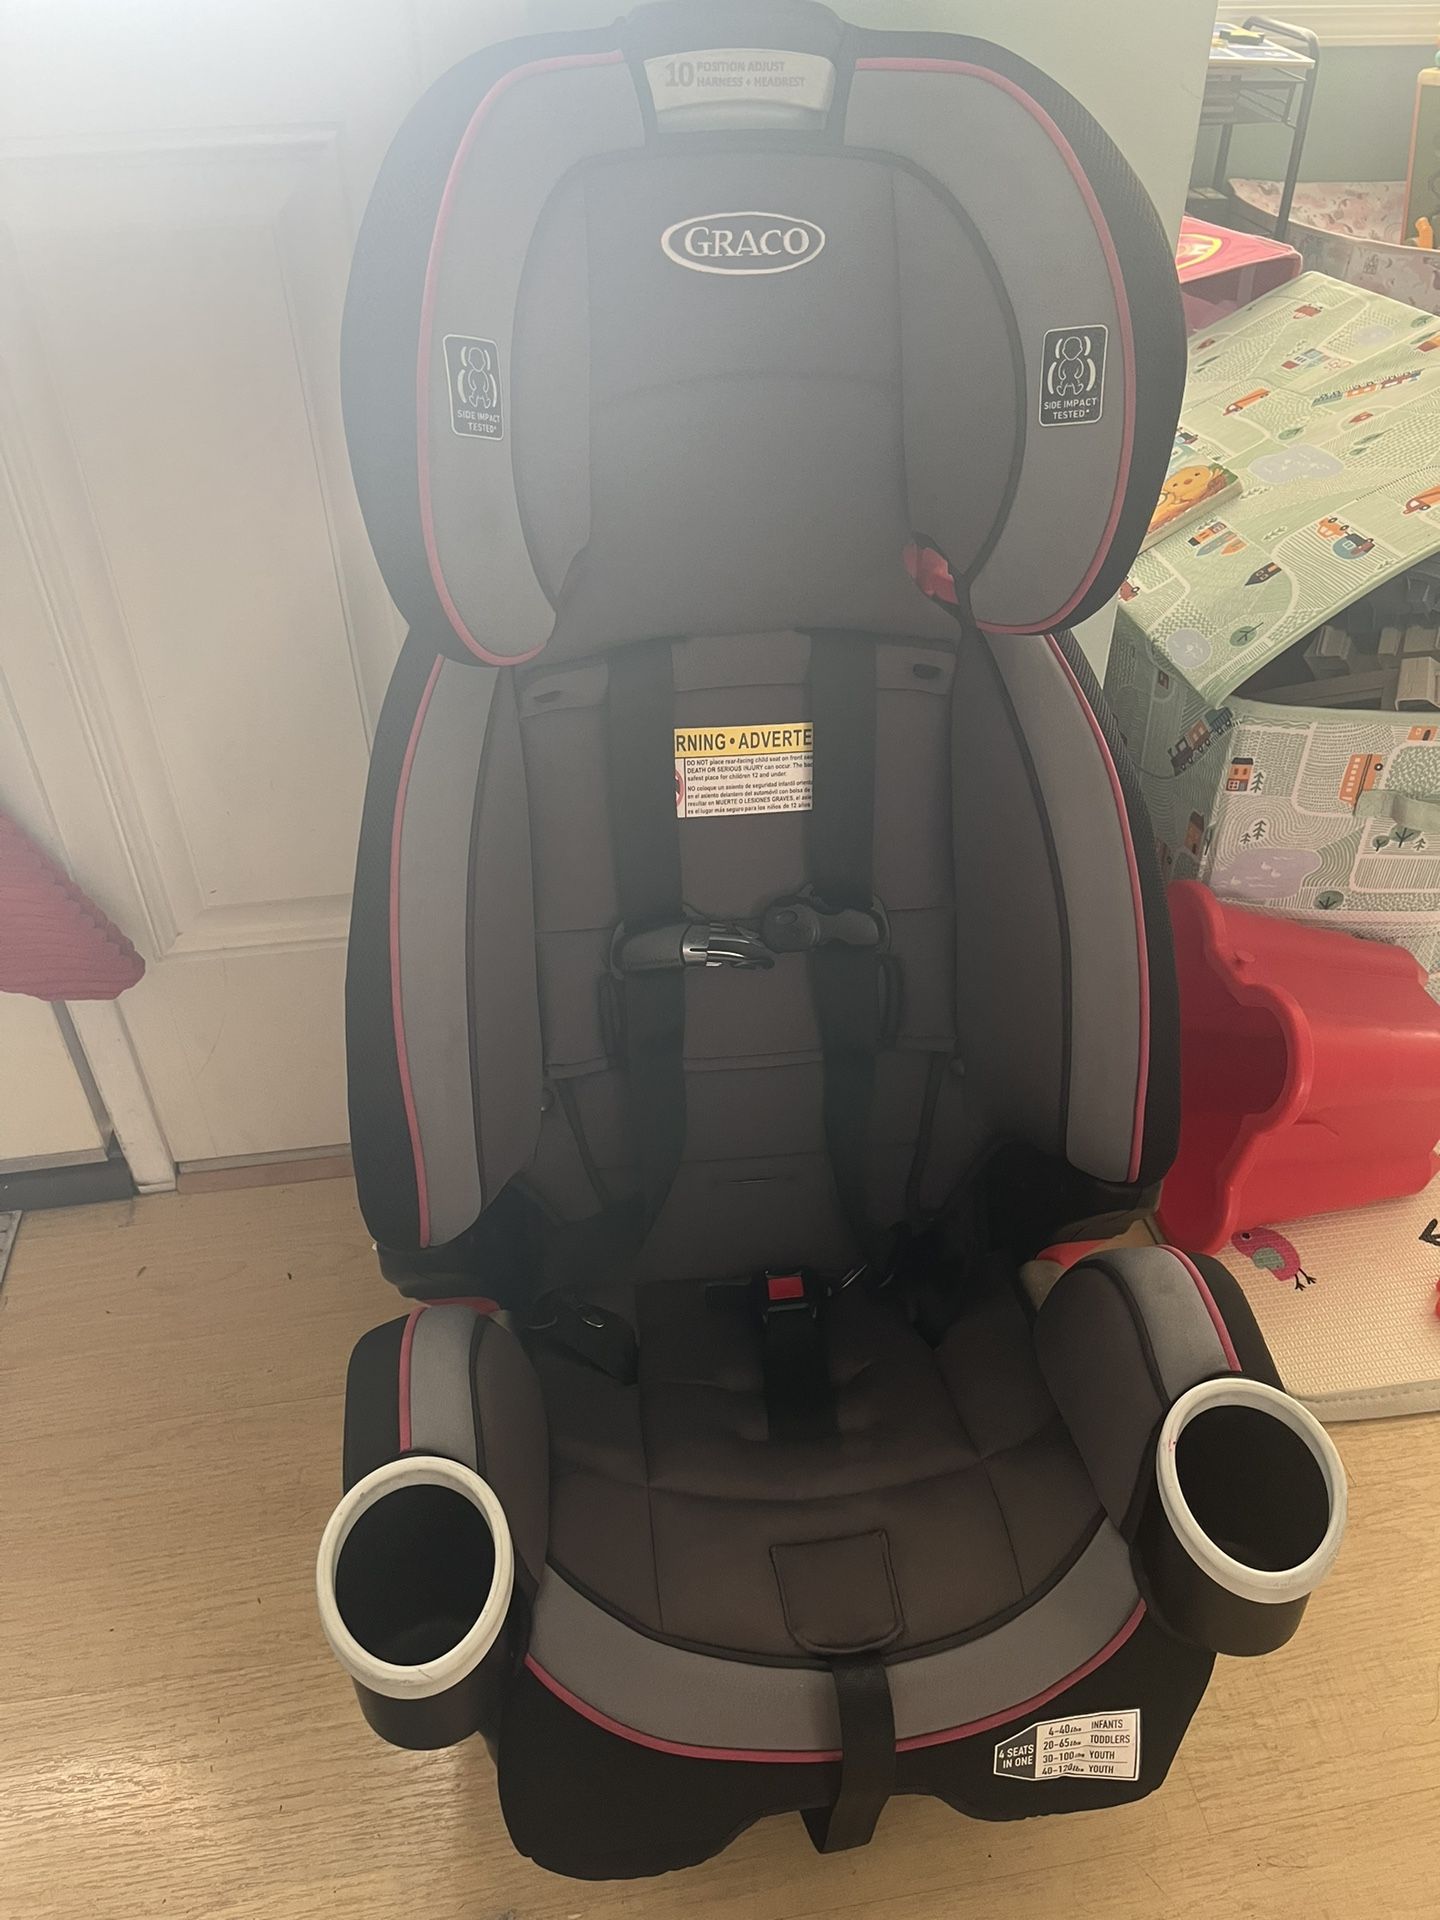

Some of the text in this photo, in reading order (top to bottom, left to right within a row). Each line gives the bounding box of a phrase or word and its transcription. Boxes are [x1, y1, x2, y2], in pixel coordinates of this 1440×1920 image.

[697, 60, 785, 73] POSITION ADJUST
[664, 62, 694, 87] 10
[697, 76, 743, 87] HARNESS
[754, 76, 805, 87] HEADREST
[685, 226, 809, 257] GRACO
[1044, 397, 1097, 410] SIDE IMPACT
[457, 409, 500, 423] SIDE IMPACT
[676, 728, 812, 752] RNING ADVERTE
[710, 758, 724, 766] place
[752, 782, 777, 790] seguridad
[715, 798, 737, 806] MUERTE
[744, 796, 770, 804] LESIONES
[1091, 1719, 1124, 1729] INFANTS
[1090, 1734, 1131, 1744] TODDLERS
[999, 1744, 1035, 1759] 4 SEATS
[1089, 1751, 1115, 1760] YOUTH
[1003, 1755, 1033, 1769] IN ONE
[1088, 1764, 1114, 1774] YOUTH
